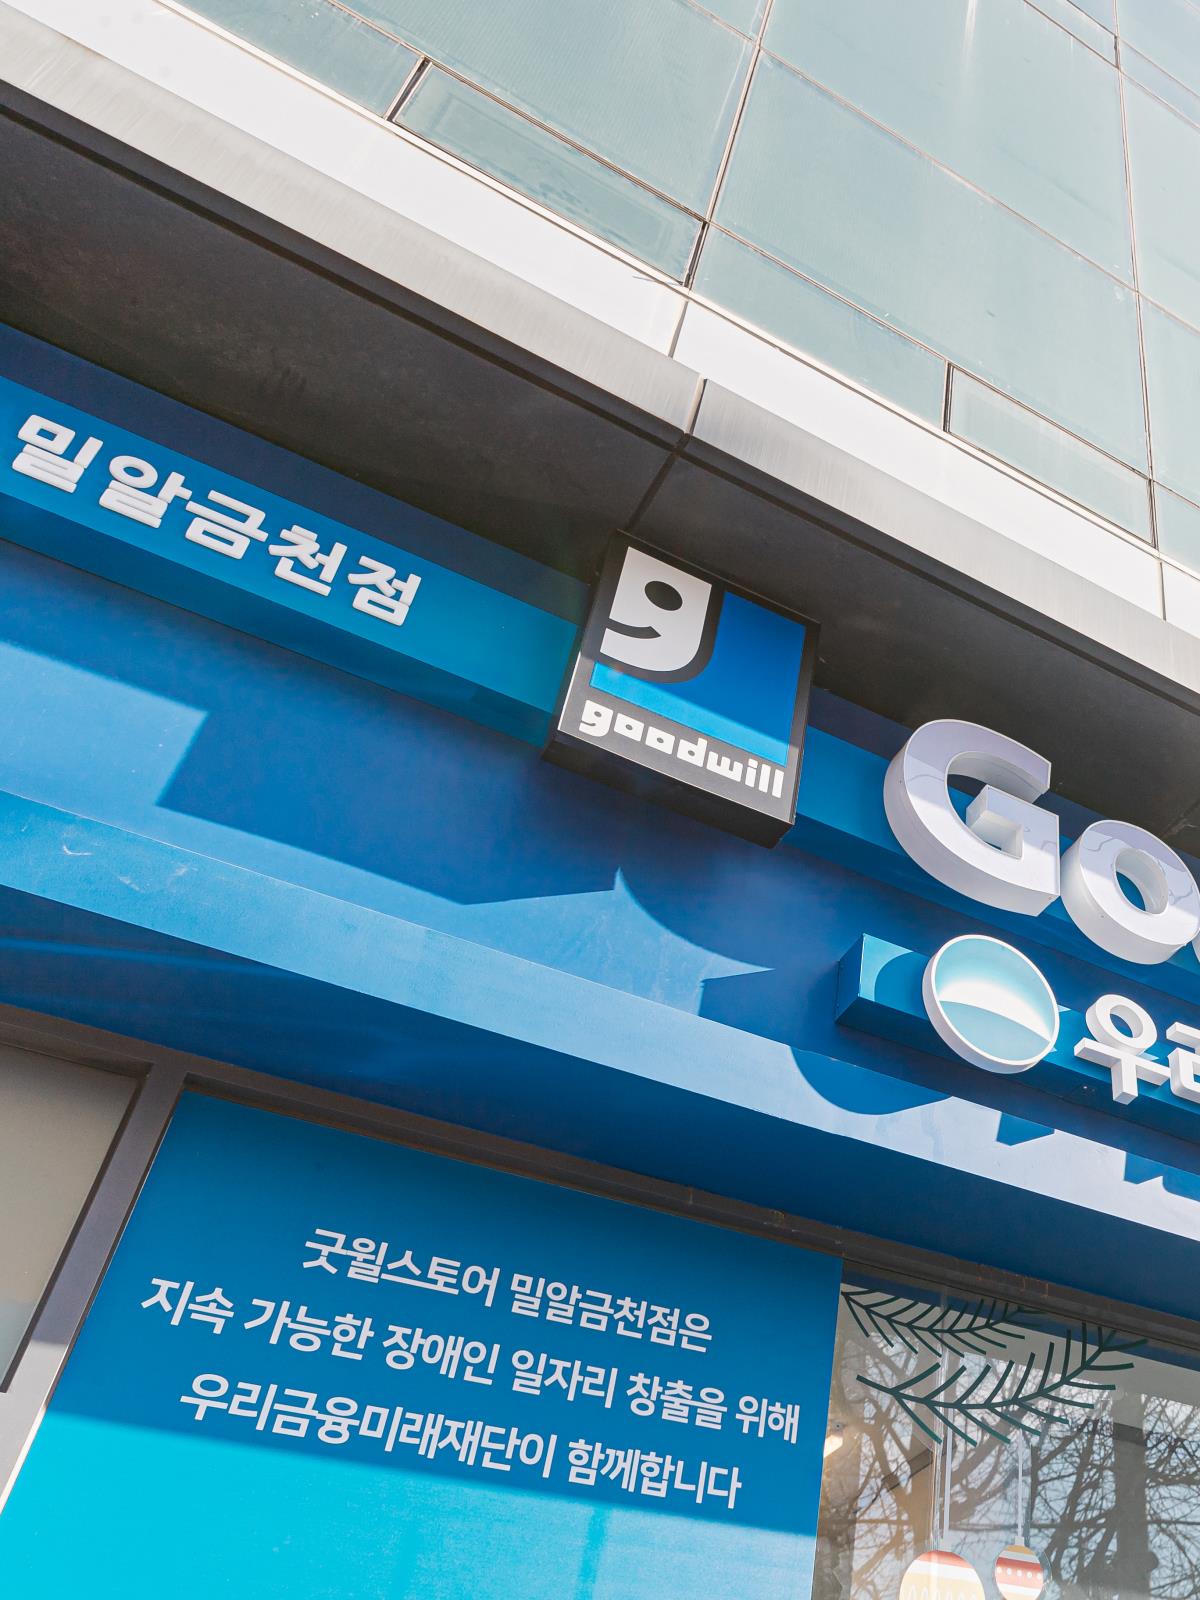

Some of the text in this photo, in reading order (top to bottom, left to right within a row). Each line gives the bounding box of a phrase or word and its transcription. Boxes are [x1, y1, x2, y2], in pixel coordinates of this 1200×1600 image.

[12, 414, 422, 627] 밀알금천점
[579, 700, 785, 798] goodwill
[303, 1228, 713, 1353] 굿윌스토어 밀알금천점은
[141, 1277, 801, 1444] 지속 가능한 장애인 일자리 창출을 위해
[180, 1373, 742, 1509] 우리금융미래재단이 함께합니다
